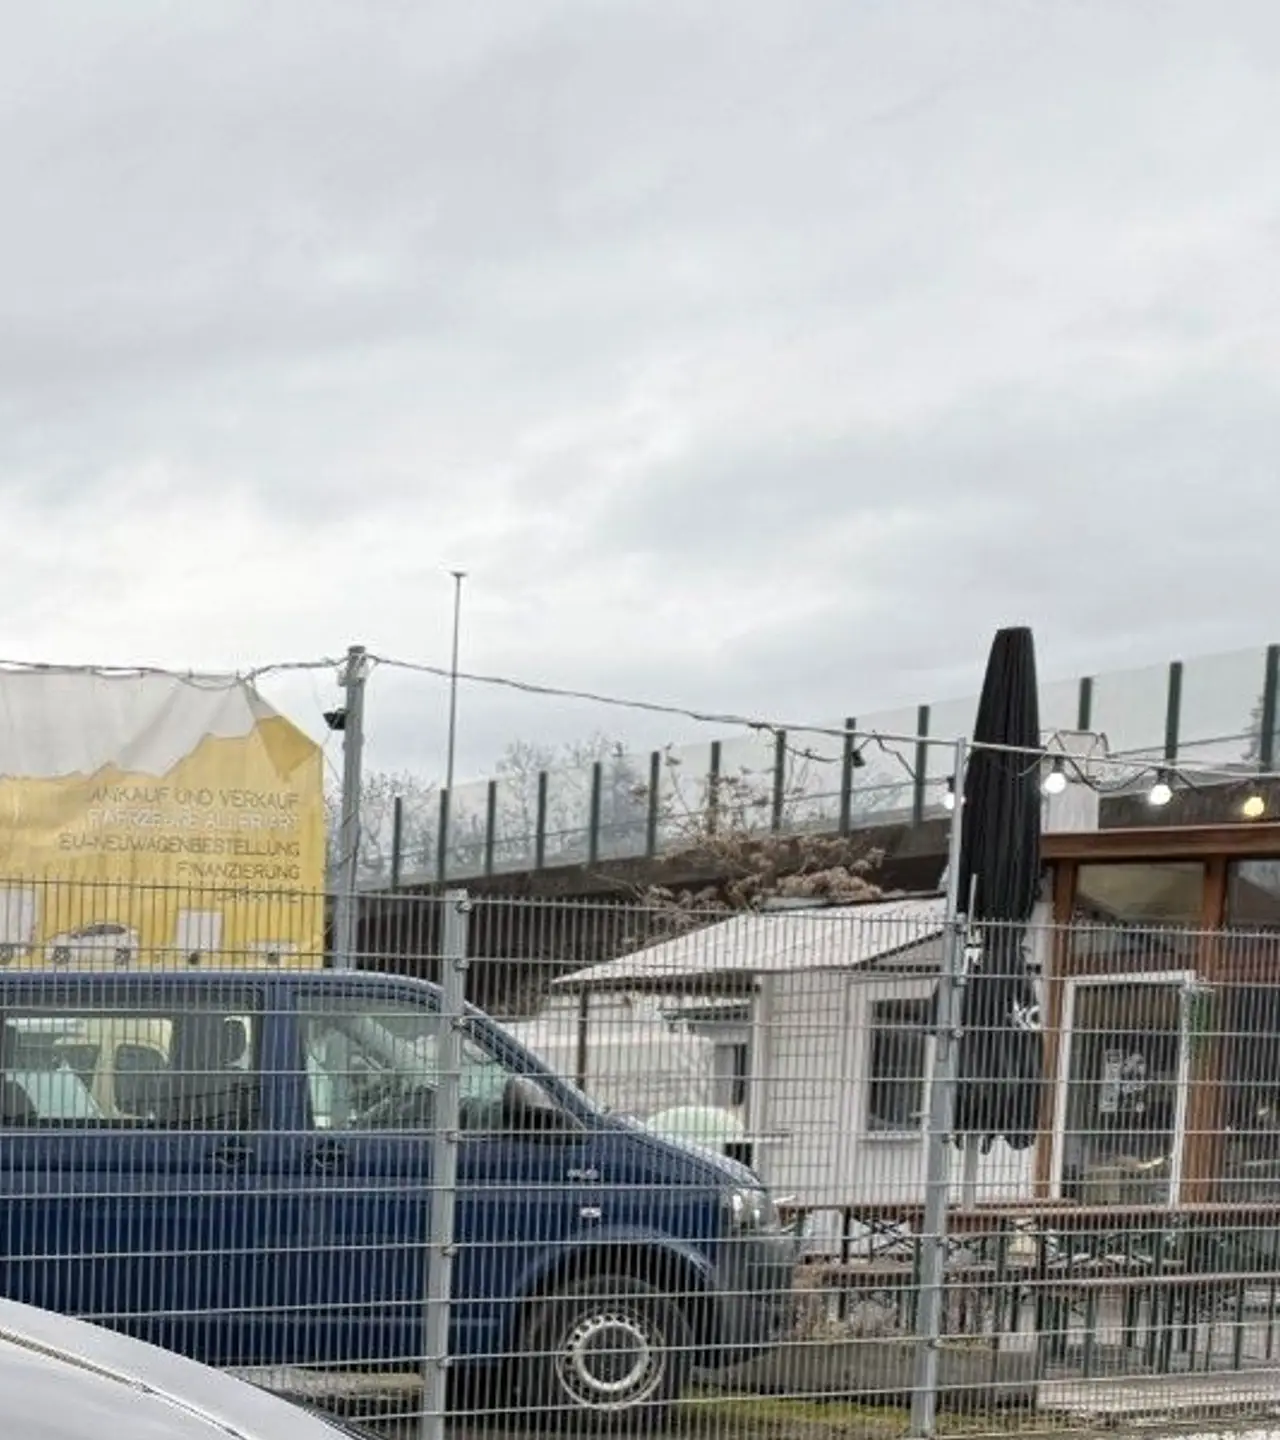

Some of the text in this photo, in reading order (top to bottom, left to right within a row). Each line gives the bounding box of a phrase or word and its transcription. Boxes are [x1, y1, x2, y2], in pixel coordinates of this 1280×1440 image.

[90, 786, 301, 811] ANKAUF UND VERKAUF
[58, 833, 301, 857] EU-NEUWAGENBESTELLUNG
[176, 861, 301, 881] FINANZIERUNG
